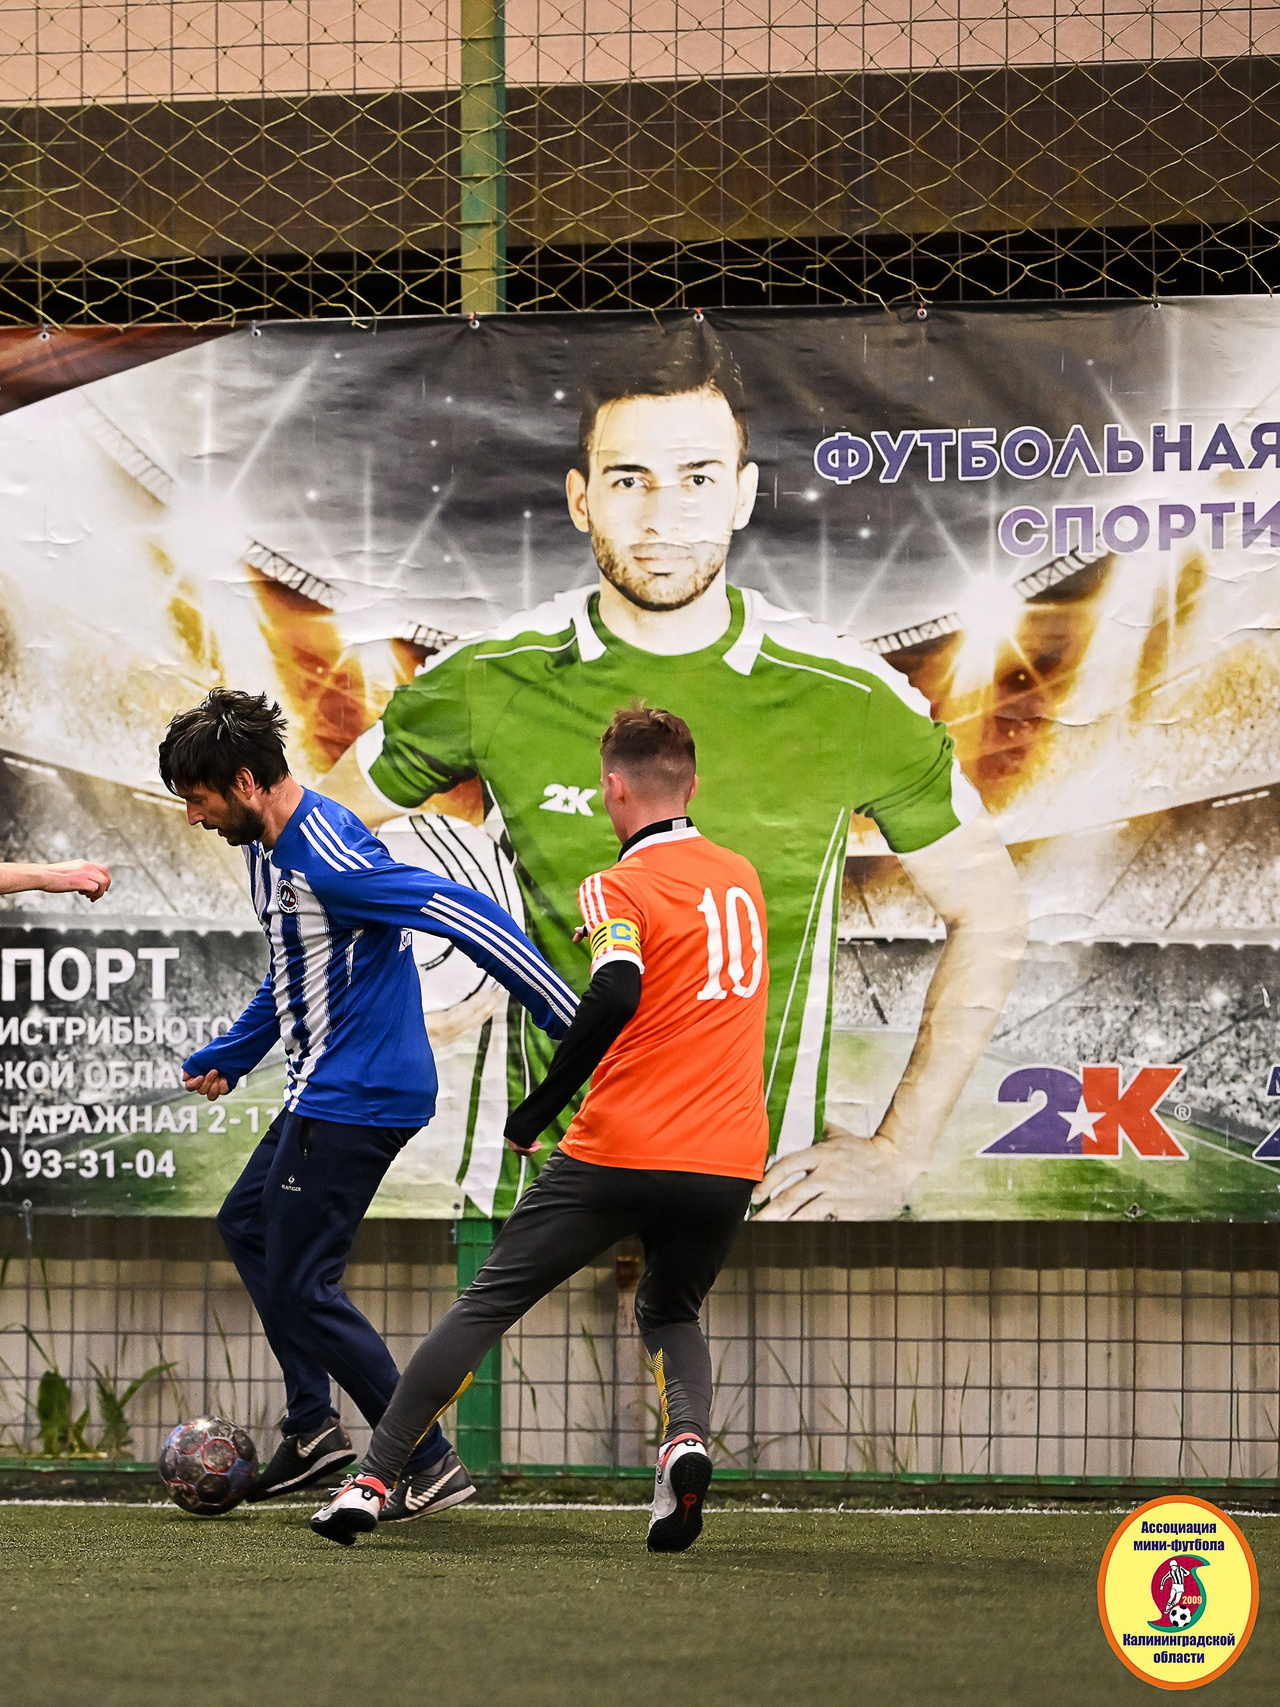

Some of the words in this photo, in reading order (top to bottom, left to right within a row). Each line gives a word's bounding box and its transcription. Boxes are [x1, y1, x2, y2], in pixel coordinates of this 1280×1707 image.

[814, 422, 1280, 484] ФУТБОЛЬНАЯ
[998, 500, 1280, 557] СПОРТИ
[539, 783, 597, 817] 2K
[697, 887, 763, 1001] 10
[9, 1104, 199, 1135] ГАРАЖНАЯ
[21, 1148, 176, 1180] 93-31-04
